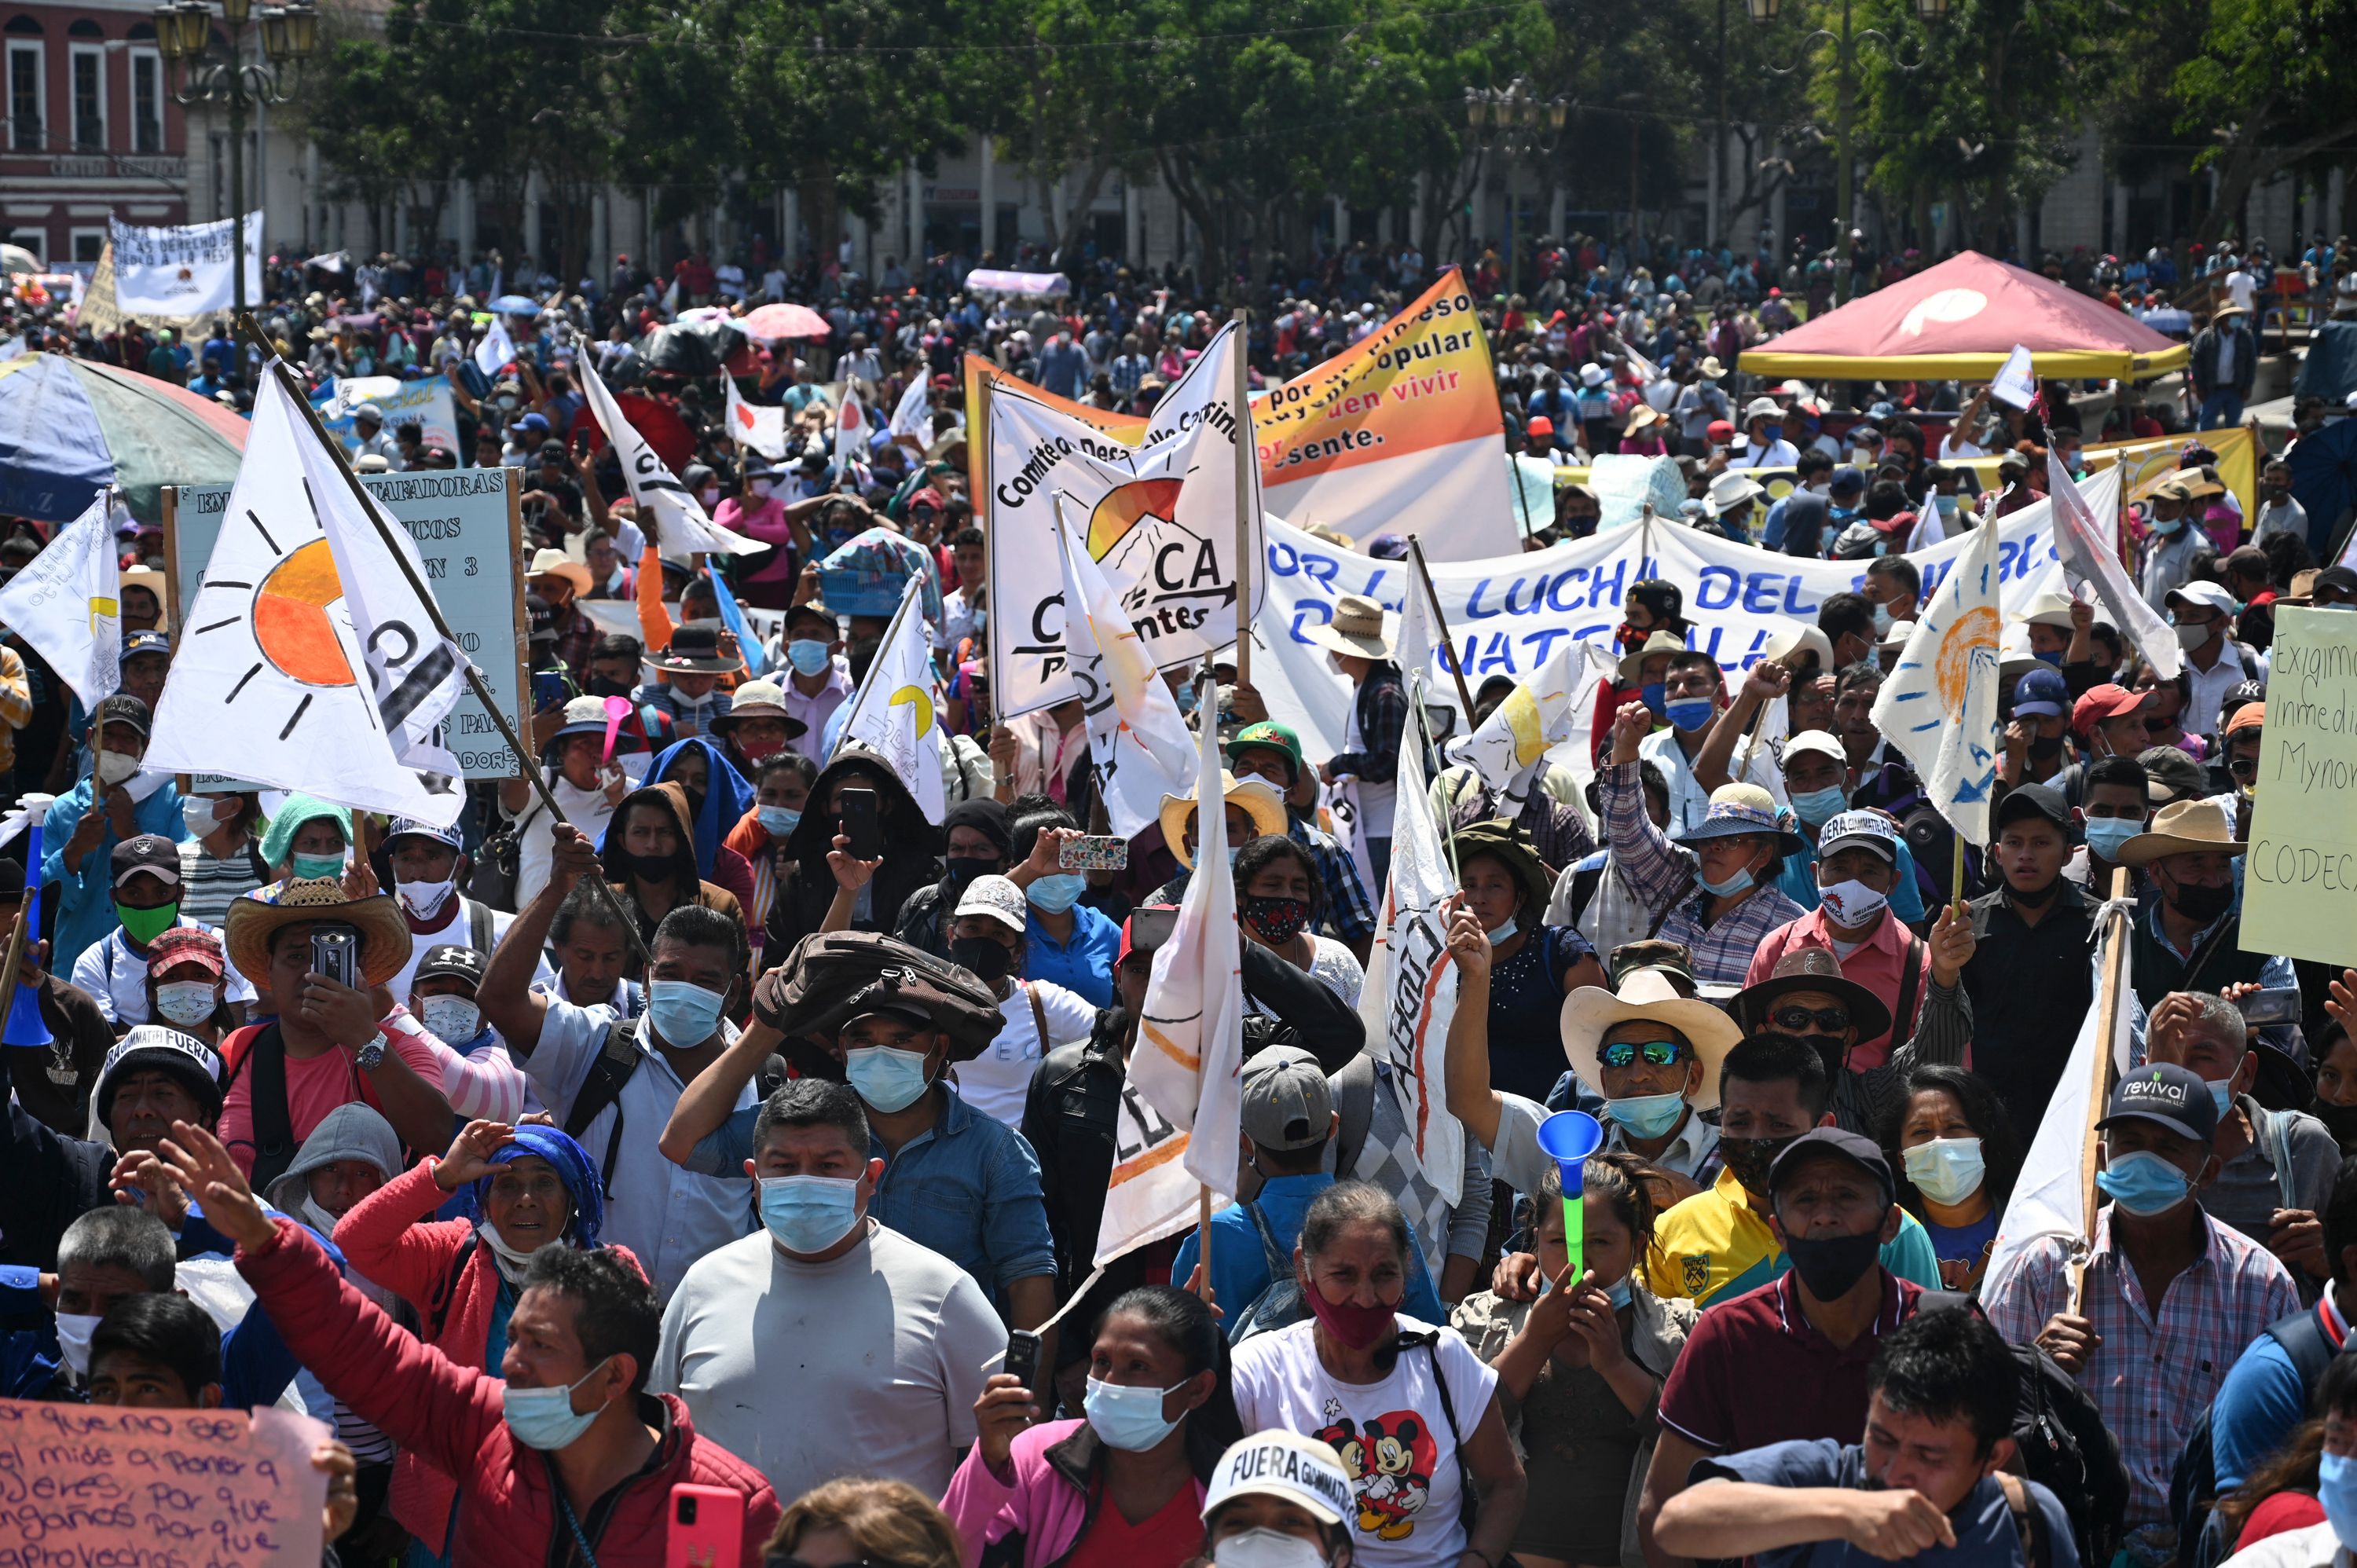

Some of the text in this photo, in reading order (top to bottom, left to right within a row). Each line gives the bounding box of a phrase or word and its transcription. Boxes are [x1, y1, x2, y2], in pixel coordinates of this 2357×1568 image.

[1270, 384, 1311, 411] por
[1392, 369, 1460, 401] vivir
[997, 437, 1058, 508] Comité
[464, 556, 478, 577] 3
[1268, 542, 1340, 595] OR
[1695, 564, 1819, 615] DEL
[2275, 632, 2357, 709] Exigim
[2253, 840, 2357, 892] CODEC
[453, 962, 481, 974] ARMOUR
[165, 1029, 209, 1064] FUERA
[2124, 1081, 2188, 1101] revival
[2149, 1094, 2172, 1104] Services
[2172, 1100, 2185, 1108] LLC
[1684, 1258, 1706, 1267] NAUTICA
[40, 1406, 114, 1438] que
[120, 1414, 173, 1436] no
[1230, 1445, 1299, 1487] FUERA
